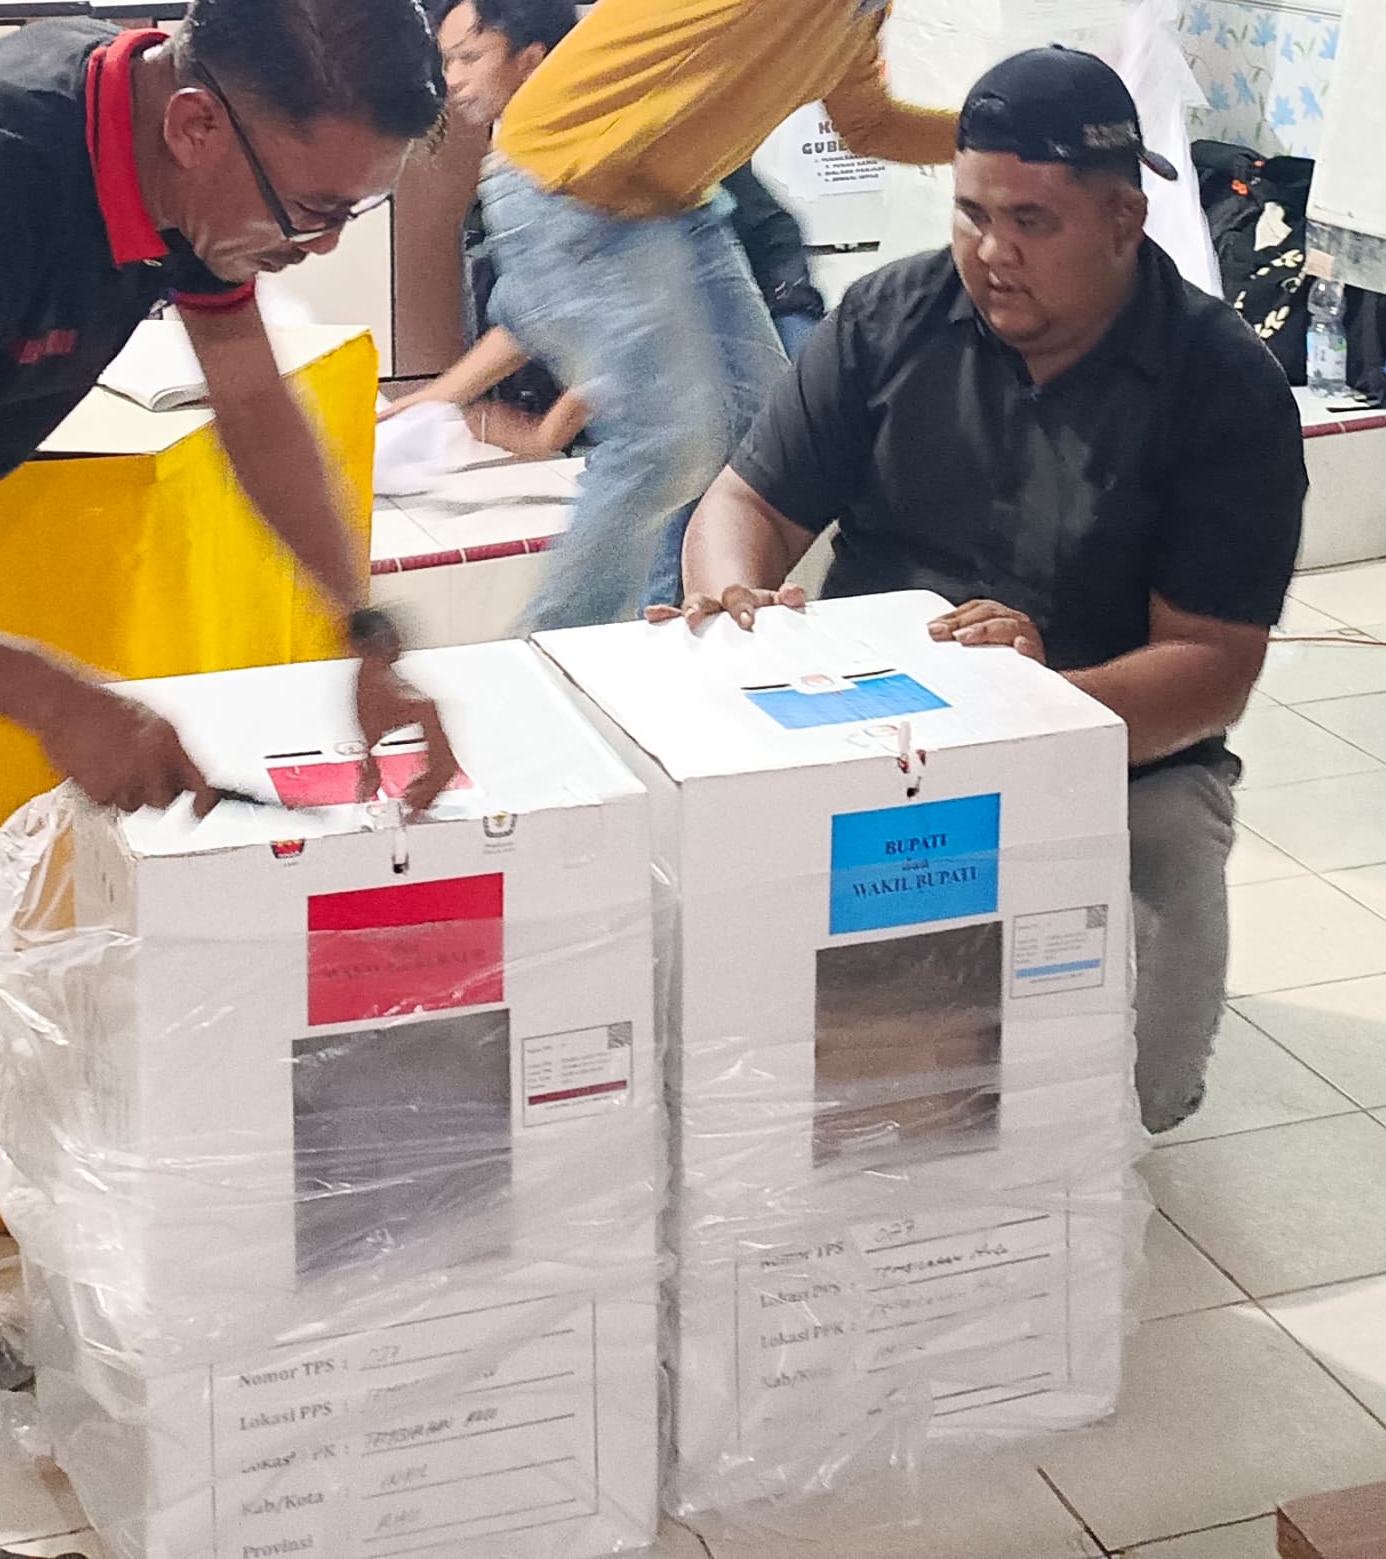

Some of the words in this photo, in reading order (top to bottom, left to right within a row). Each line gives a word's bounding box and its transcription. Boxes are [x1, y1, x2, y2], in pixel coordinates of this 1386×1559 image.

[885, 833, 947, 855] BUPATI
[852, 877, 912, 898] WAKIL
[916, 866, 977, 889] BUPATI
[239, 1366, 299, 1388] Nomor
[302, 1358, 336, 1377] TPS
[239, 1407, 296, 1431] Lokasi
[299, 1401, 333, 1421] PPS
[242, 1491, 324, 1515] Kab/Kota
